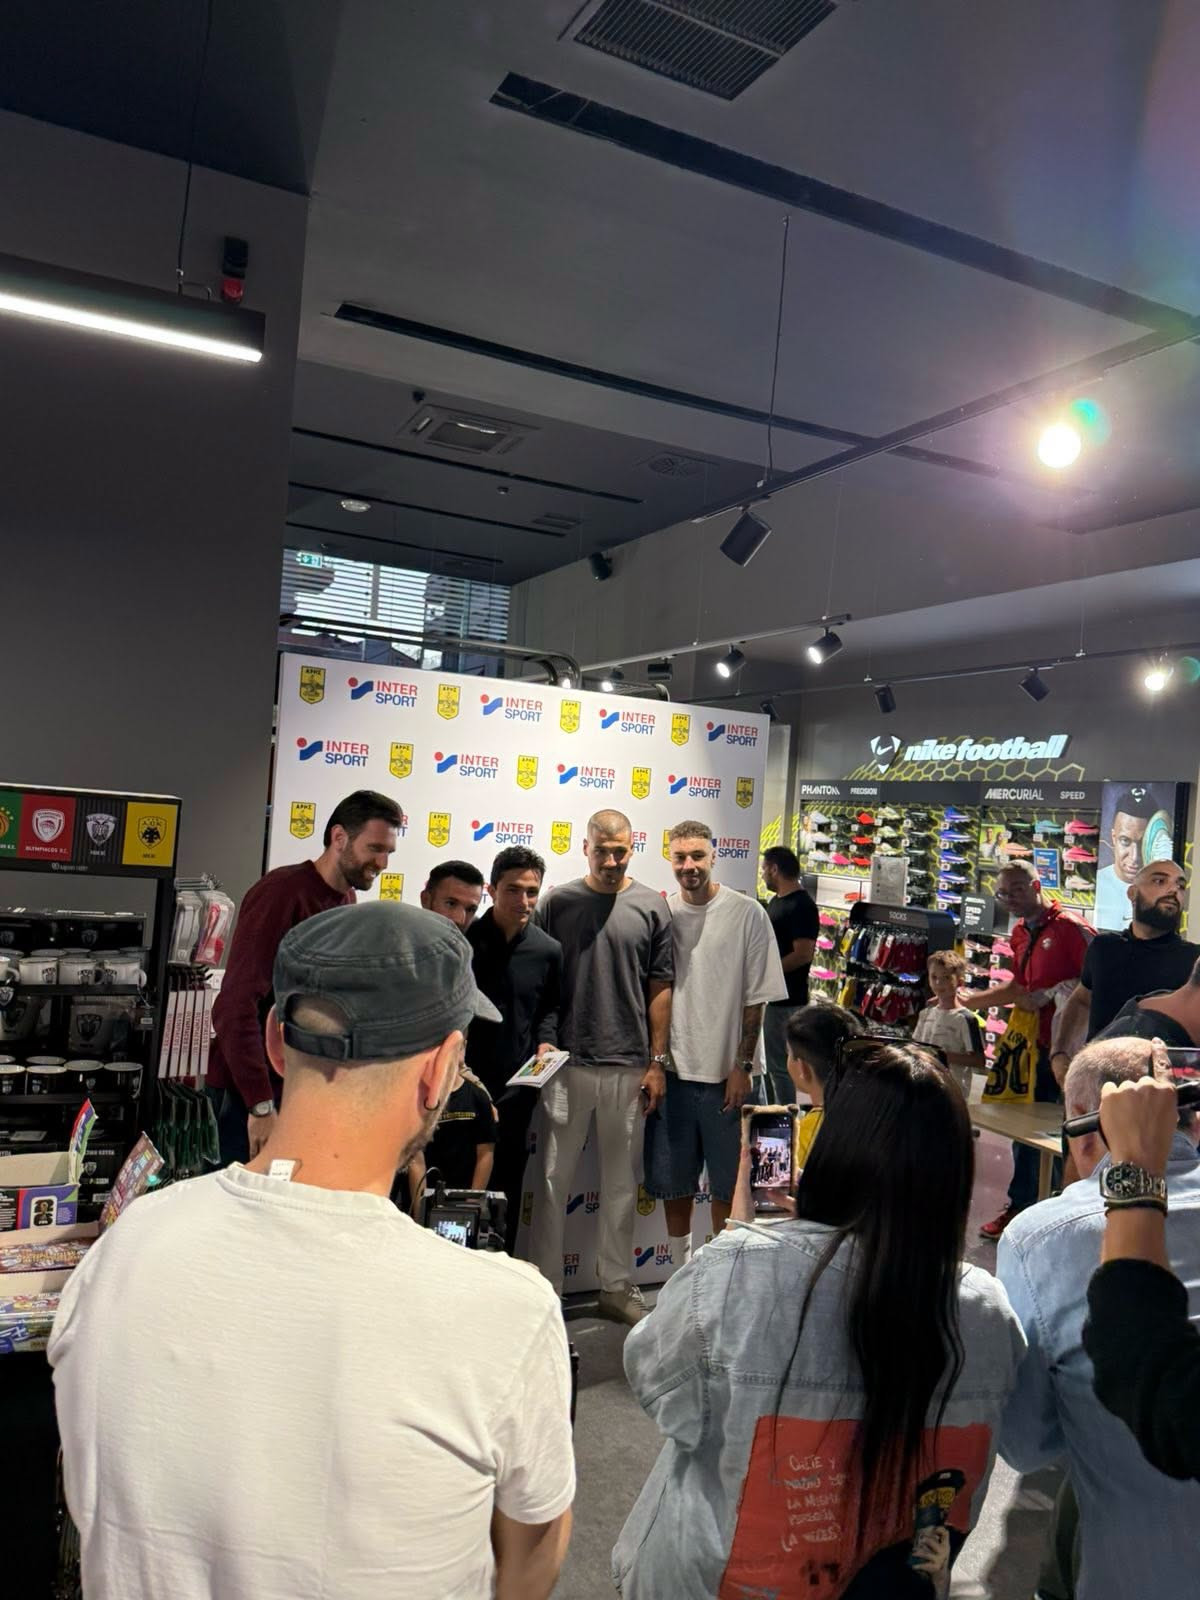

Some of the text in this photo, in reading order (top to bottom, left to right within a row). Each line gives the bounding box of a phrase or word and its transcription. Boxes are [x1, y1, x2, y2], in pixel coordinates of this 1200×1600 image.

[376, 680, 418, 696] INTER
[375, 692, 417, 707] SPORT
[505, 697, 543, 711] INTER
[504, 708, 542, 722] SPORT
[621, 712, 656, 725] INTER
[620, 722, 655, 735] SPORT
[727, 723, 758, 736] INTER
[726, 734, 758, 747] SPORT
[326, 740, 369, 755] INTER
[325, 753, 368, 767] SPORT
[460, 753, 499, 768] INTER
[459, 765, 498, 779] SPORT
[580, 766, 615, 779] INTER
[579, 777, 615, 790] SPORT
[689, 776, 722, 788] INTER
[688, 787, 721, 799] SPORT
[801, 784, 878, 795] PHANTOM PRECISION
[985, 788, 1085, 800] MERCURIAL SPEED
[496, 821, 534, 834] INTER
[495, 833, 533, 845] SPORT
[719, 837, 750, 848] INTER
[718, 848, 750, 859] SPORT
[889, 911, 908, 921] SOCKS
